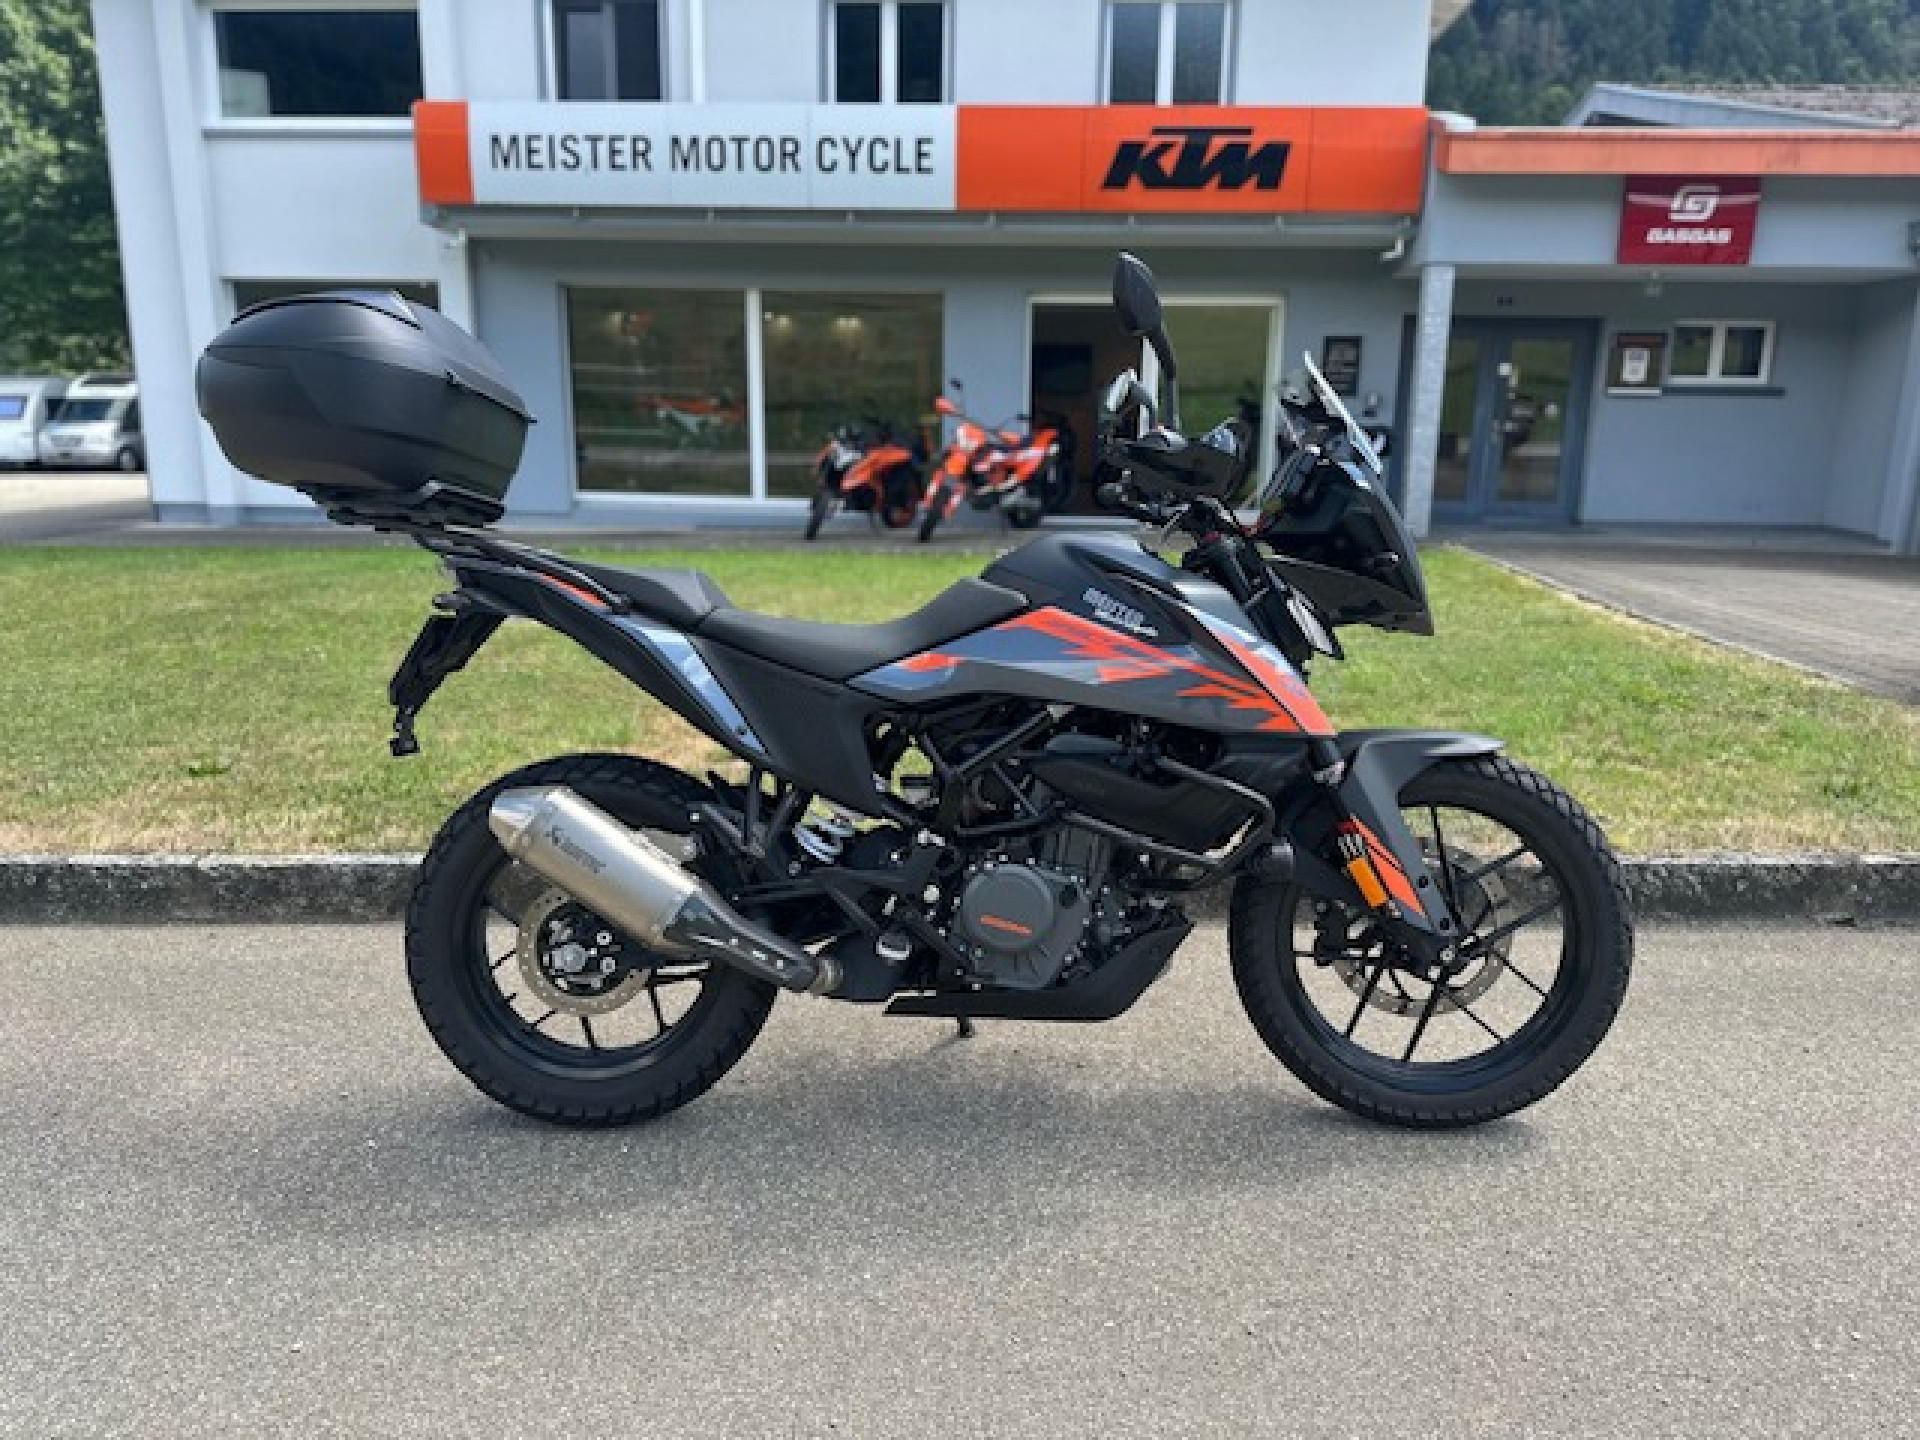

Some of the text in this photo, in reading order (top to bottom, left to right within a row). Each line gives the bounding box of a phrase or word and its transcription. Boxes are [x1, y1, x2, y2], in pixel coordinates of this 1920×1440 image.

[490, 134, 935, 174] MEISTER MOTOR CYCLE
[1103, 126, 1292, 190] KTM
[1646, 227, 1732, 244] GASGAS
